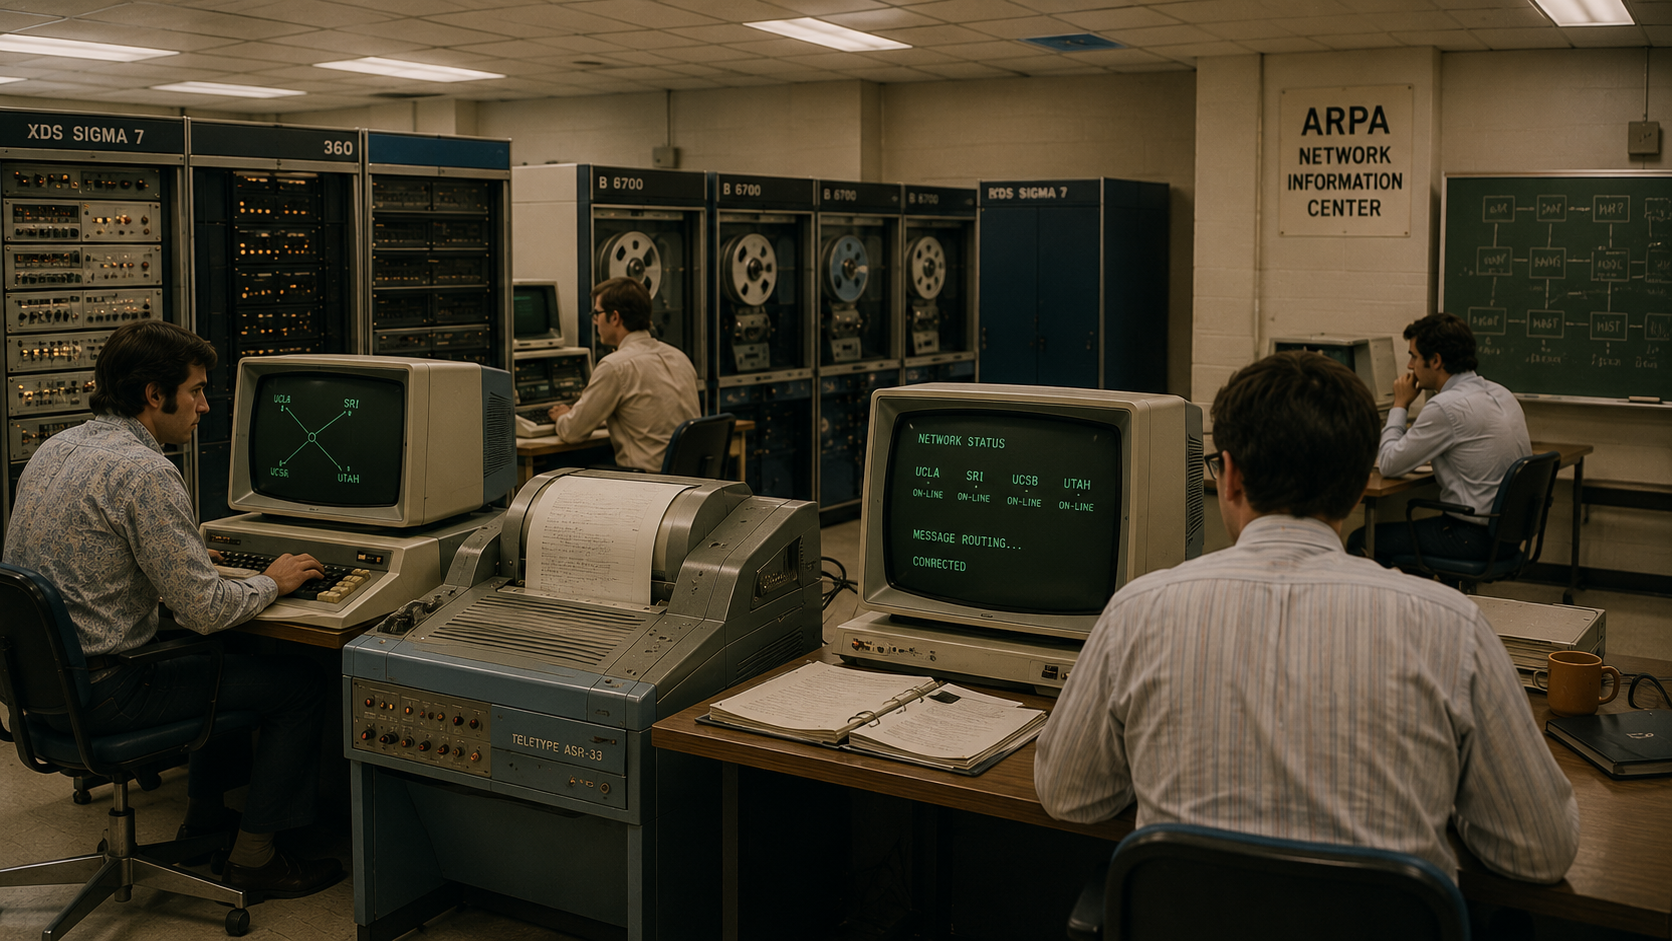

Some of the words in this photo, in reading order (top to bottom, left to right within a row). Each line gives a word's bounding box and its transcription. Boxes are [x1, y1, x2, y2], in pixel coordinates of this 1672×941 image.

[1301, 104, 1390, 136] ARPA
[27, 123, 63, 140] XDS
[73, 125, 128, 144] SIGMA
[134, 129, 145, 145] 7
[324, 140, 353, 156] 360
[1299, 145, 1392, 165] NETWORK
[599, 176, 608, 189] B
[613, 176, 644, 191] 6700
[723, 182, 731, 195] B
[735, 183, 761, 197] 6700
[1287, 172, 1403, 191] INFORMATION
[1018, 186, 1057, 199] SIGMA
[1059, 186, 1068, 199] 7
[1307, 198, 1381, 217] CENTER
[343, 398, 359, 409] SRI
[918, 433, 962, 446] NETWORK
[967, 436, 1006, 449] STATUS
[337, 473, 360, 484] UTAH
[915, 466, 940, 478] UCLA
[966, 470, 984, 482] SRI
[1012, 474, 1039, 487] UCSB
[1063, 477, 1091, 491] UTAH
[912, 488, 944, 500] ON-LINE
[957, 492, 991, 503] ON-LINE
[1007, 496, 1042, 508] ON-LINE
[1058, 500, 1094, 512] ON-LINE
[912, 528, 956, 544] MESSAGE
[961, 534, 1022, 550] ROUTING...
[512, 733, 560, 753] TELETYPE
[564, 744, 603, 761] ASR-33
